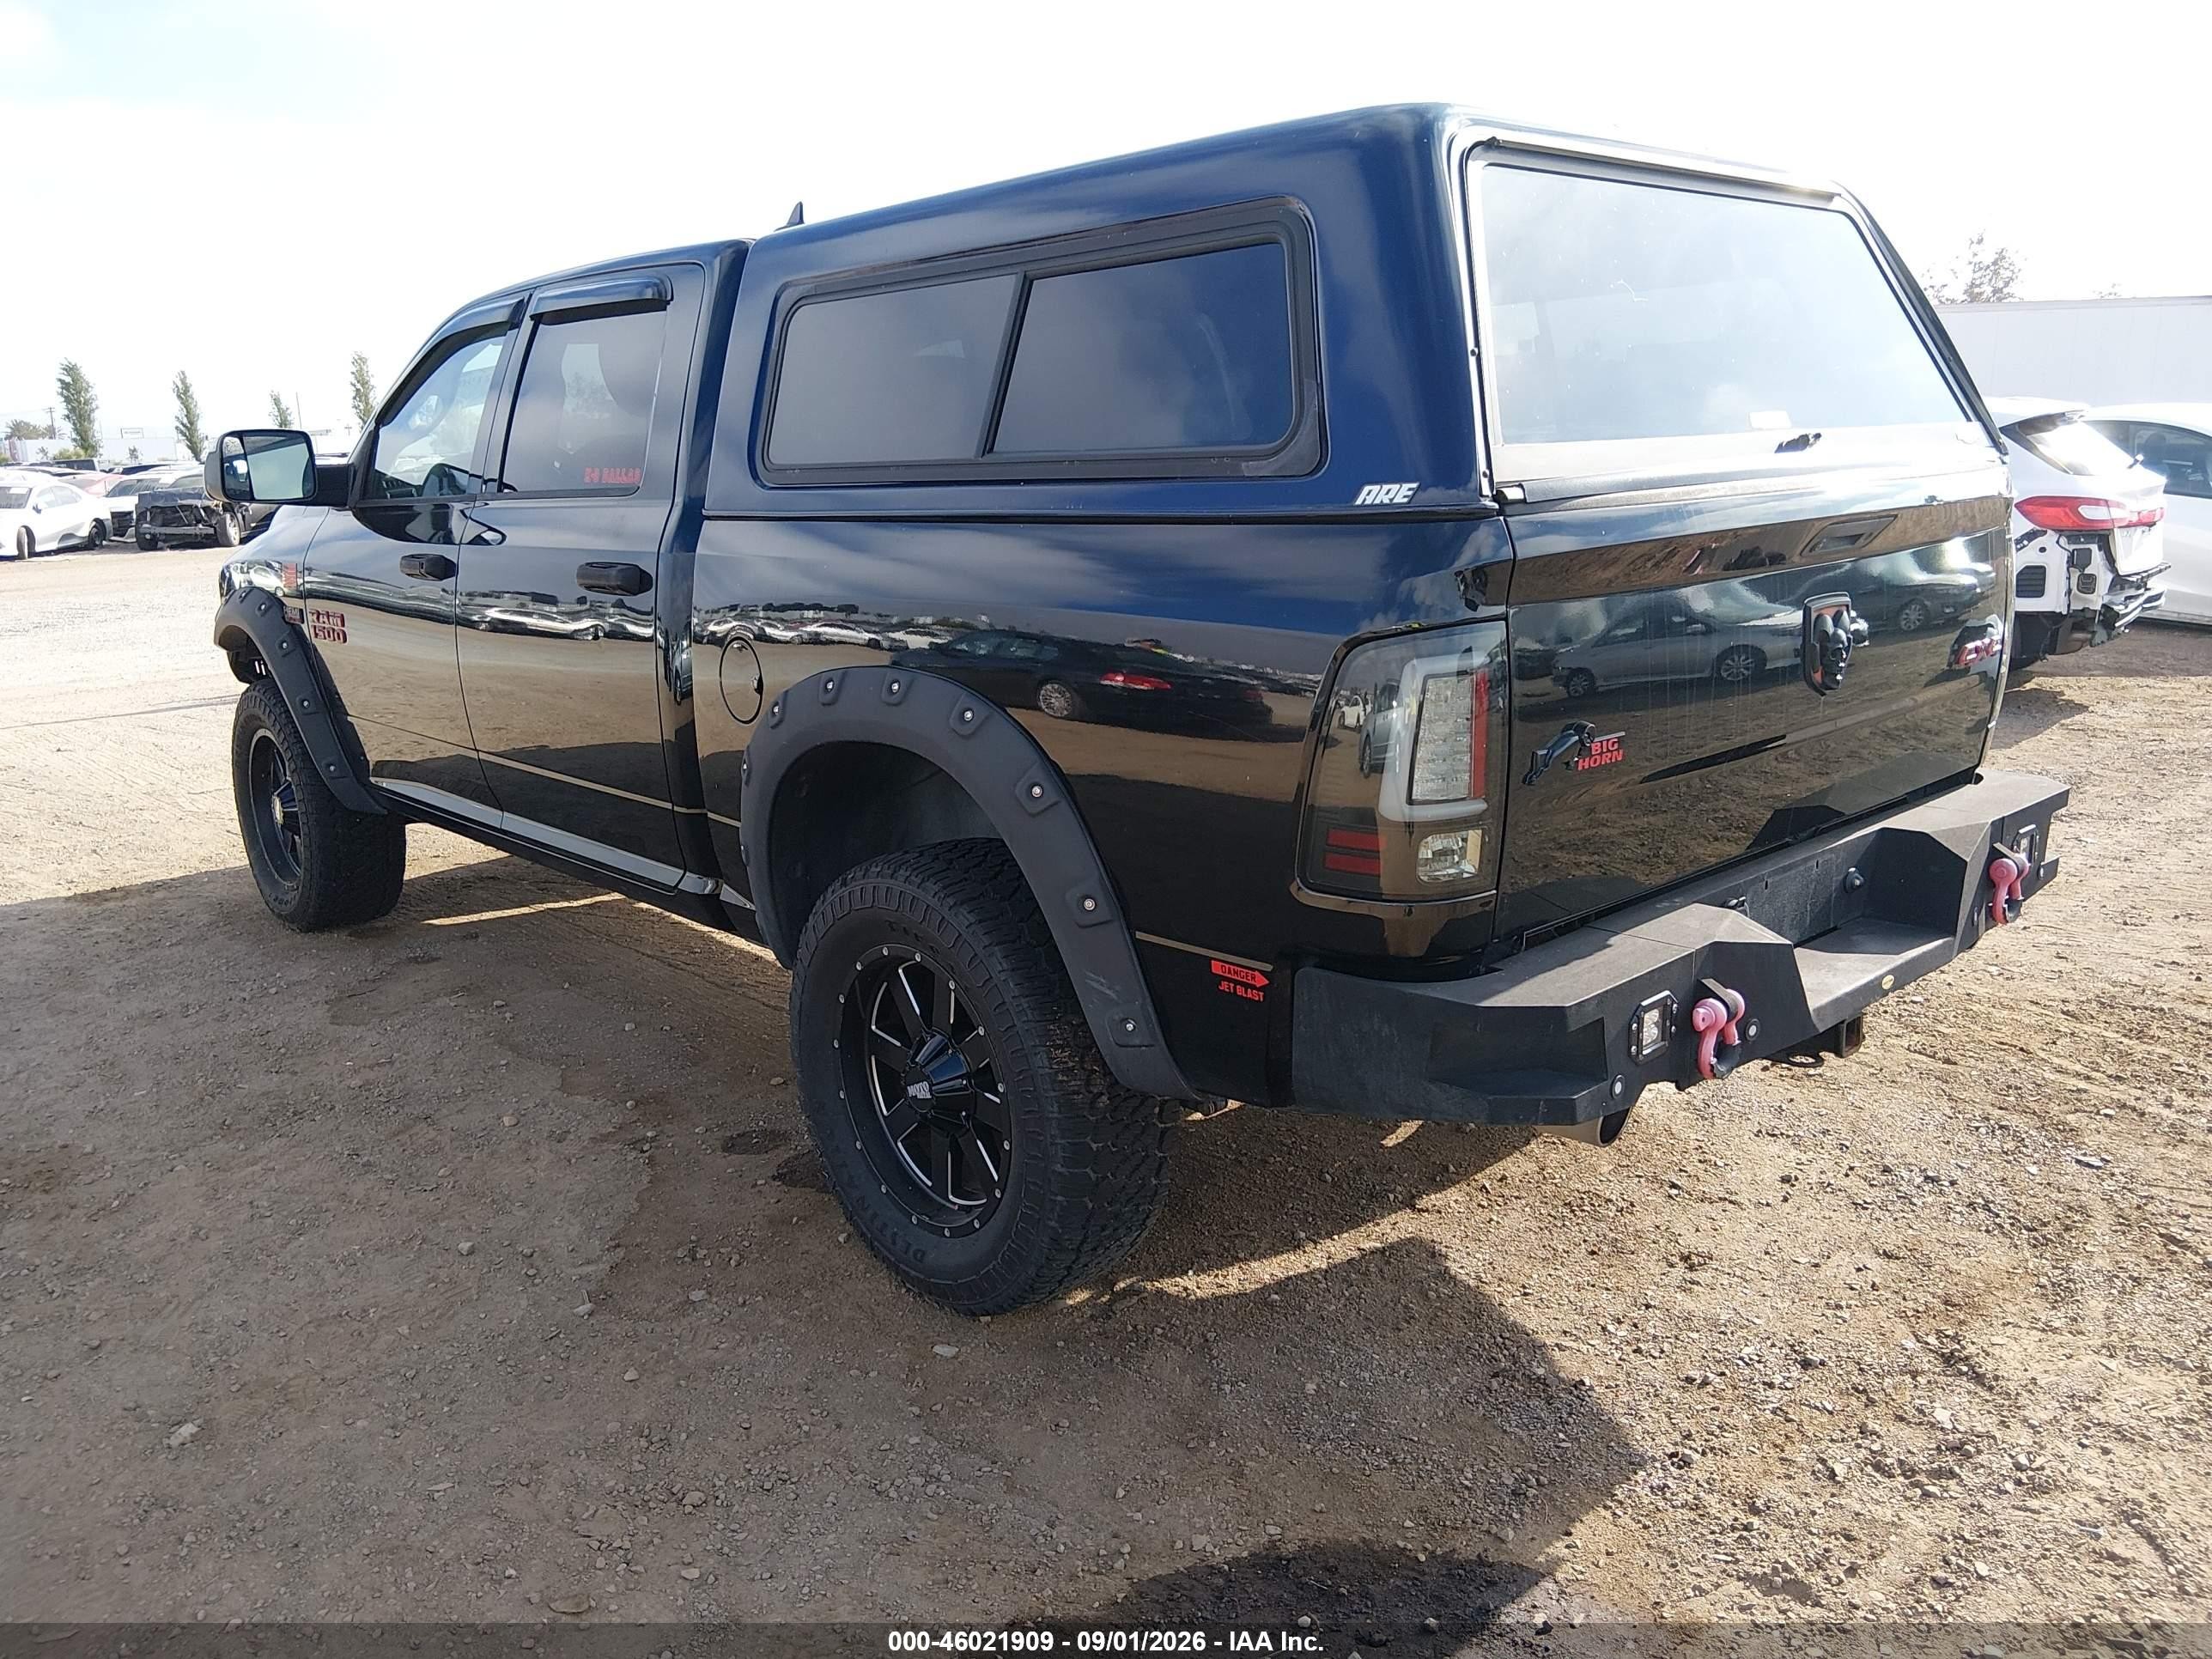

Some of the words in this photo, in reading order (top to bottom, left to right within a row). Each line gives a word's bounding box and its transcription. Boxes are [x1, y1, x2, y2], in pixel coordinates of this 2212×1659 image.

[1354, 483, 1419, 505] ARE
[309, 610, 345, 628] RAM
[1590, 738, 1619, 755] BIG
[1577, 750, 1624, 770] HORN
[1220, 964, 1256, 982] DANGER
[1218, 981, 1235, 994] JET
[1237, 985, 1265, 1002] BLAST
